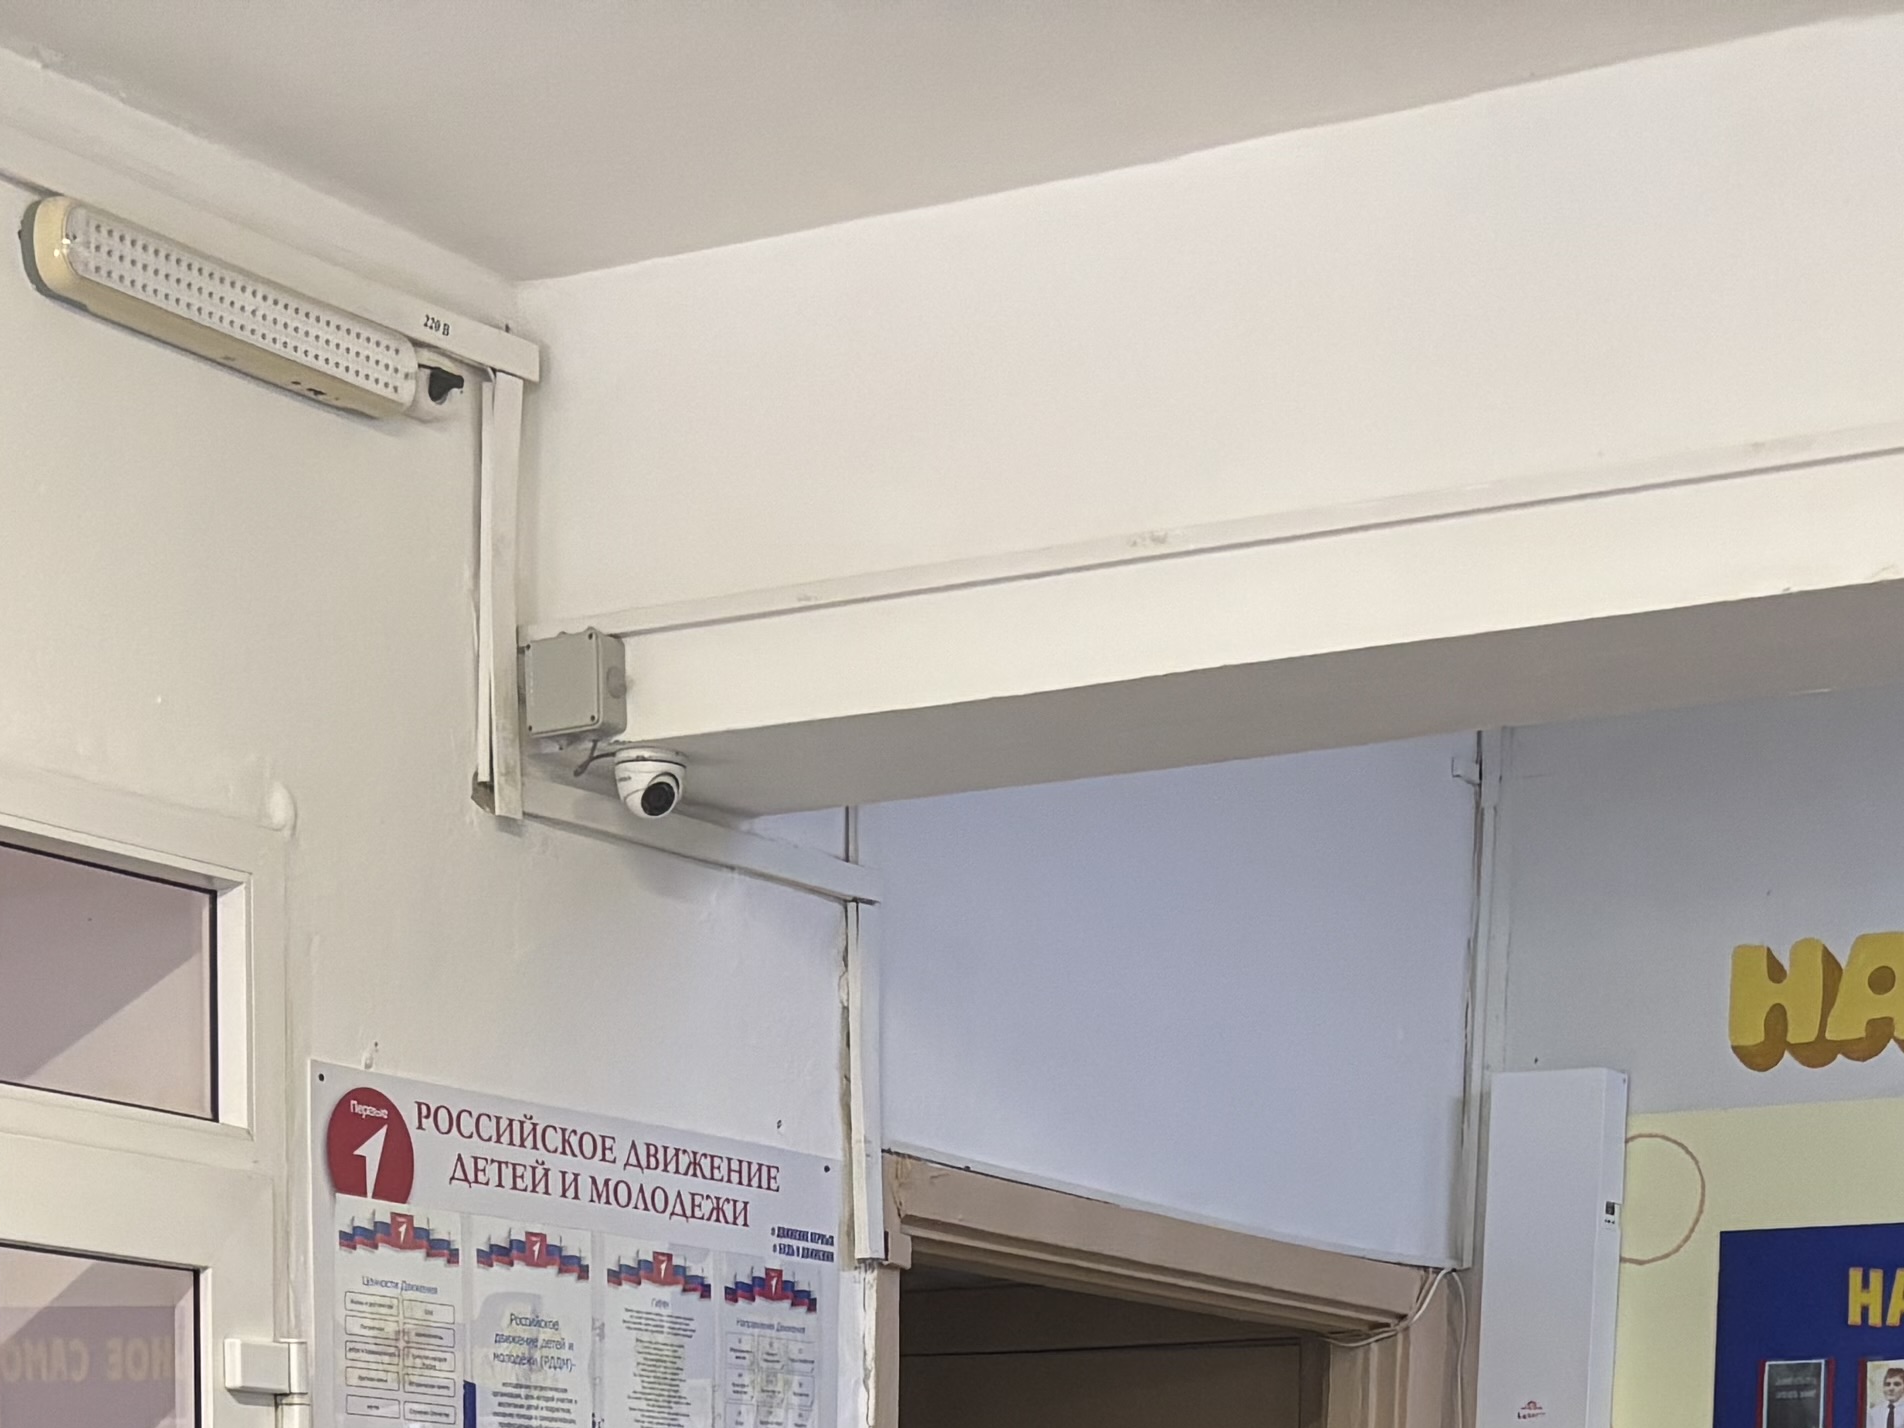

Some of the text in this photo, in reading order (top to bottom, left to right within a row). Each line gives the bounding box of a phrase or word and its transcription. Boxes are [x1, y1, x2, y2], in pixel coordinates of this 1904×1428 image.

[415, 1101, 780, 1193] РОССИЙСКОЕ ДВИЖЕНИЕ
[449, 1152, 750, 1228] ДЕТЕЙ И МОЛОДЕЖИ
